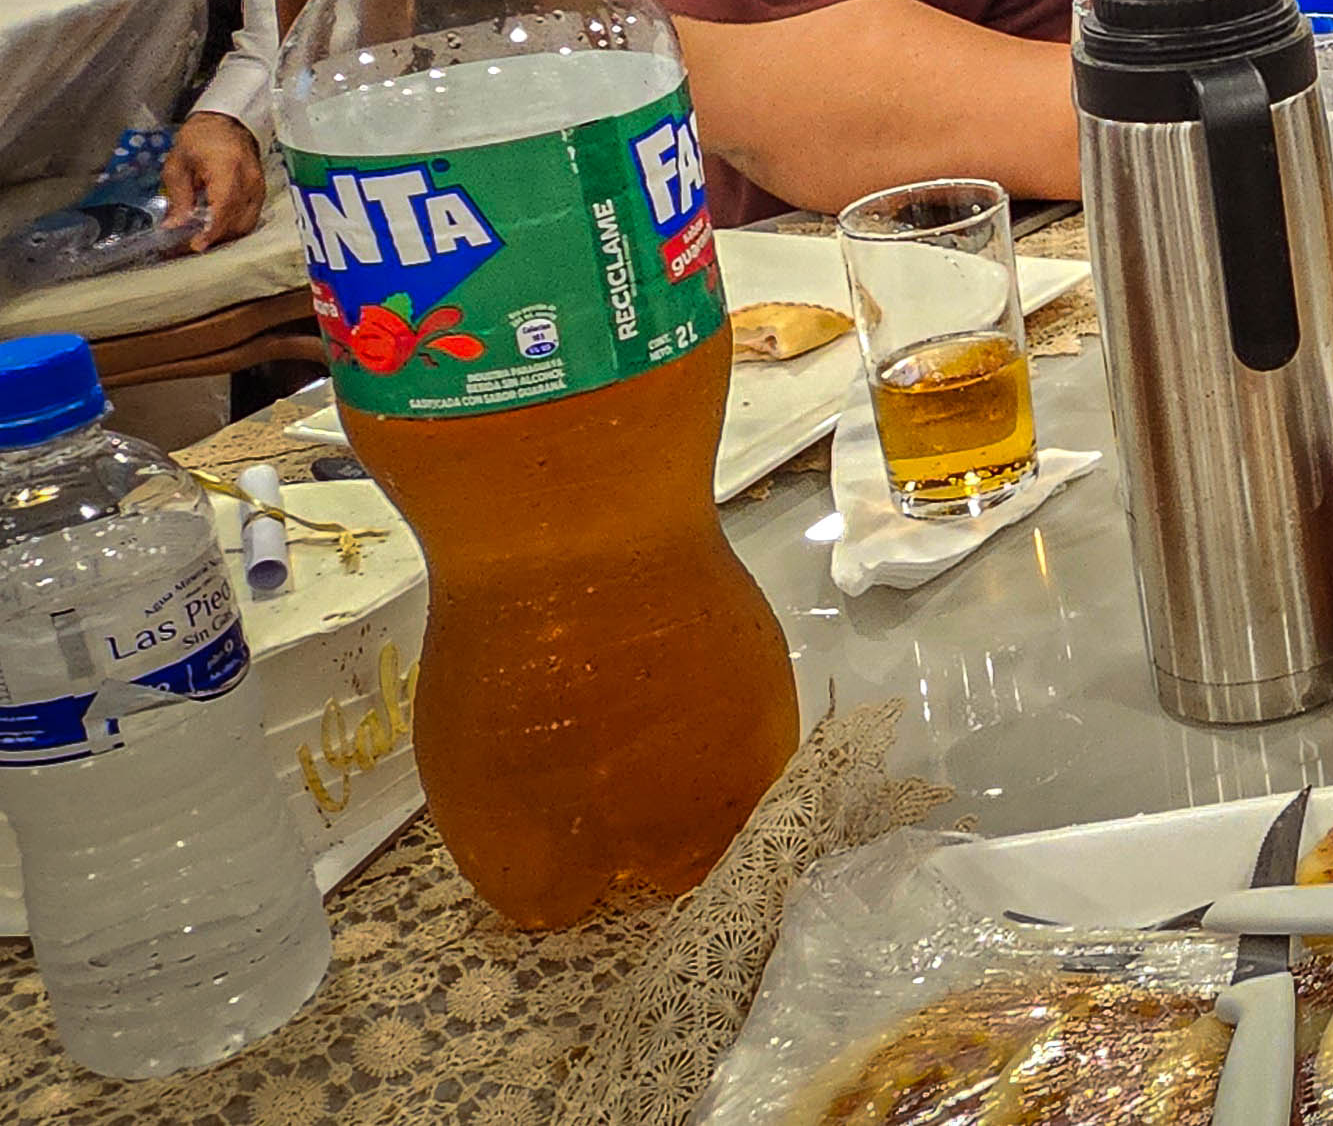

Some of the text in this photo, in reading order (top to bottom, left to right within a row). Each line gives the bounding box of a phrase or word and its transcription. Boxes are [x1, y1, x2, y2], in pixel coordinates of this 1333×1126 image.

[635, 111, 706, 225] FA
[290, 170, 492, 270] ANTA
[592, 199, 639, 341] RECICLAME
[675, 321, 698, 349] 2L
[105, 620, 177, 661] Las
